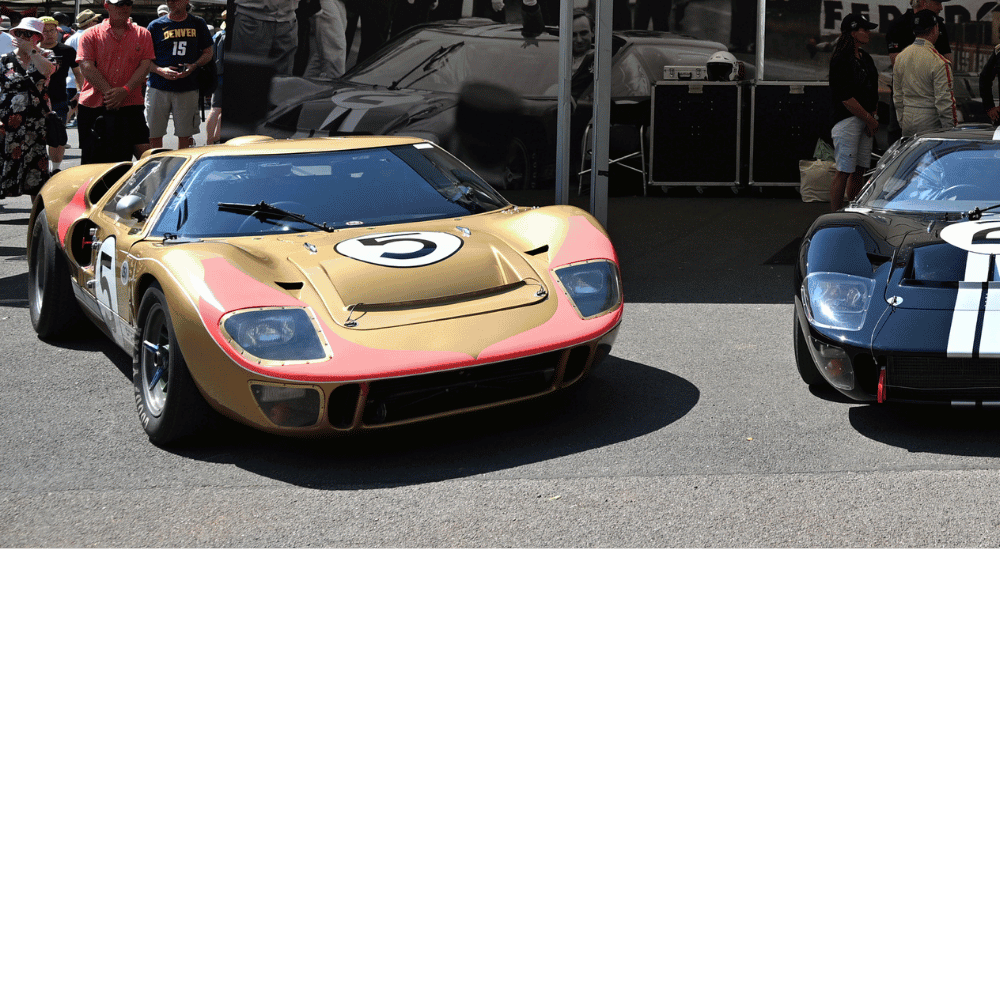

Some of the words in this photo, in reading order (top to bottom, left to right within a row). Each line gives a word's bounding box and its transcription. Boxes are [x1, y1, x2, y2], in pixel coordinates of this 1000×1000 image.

[163, 28, 197, 39] DENVER
[172, 41, 187, 56] 15
[356, 232, 438, 260] 5
